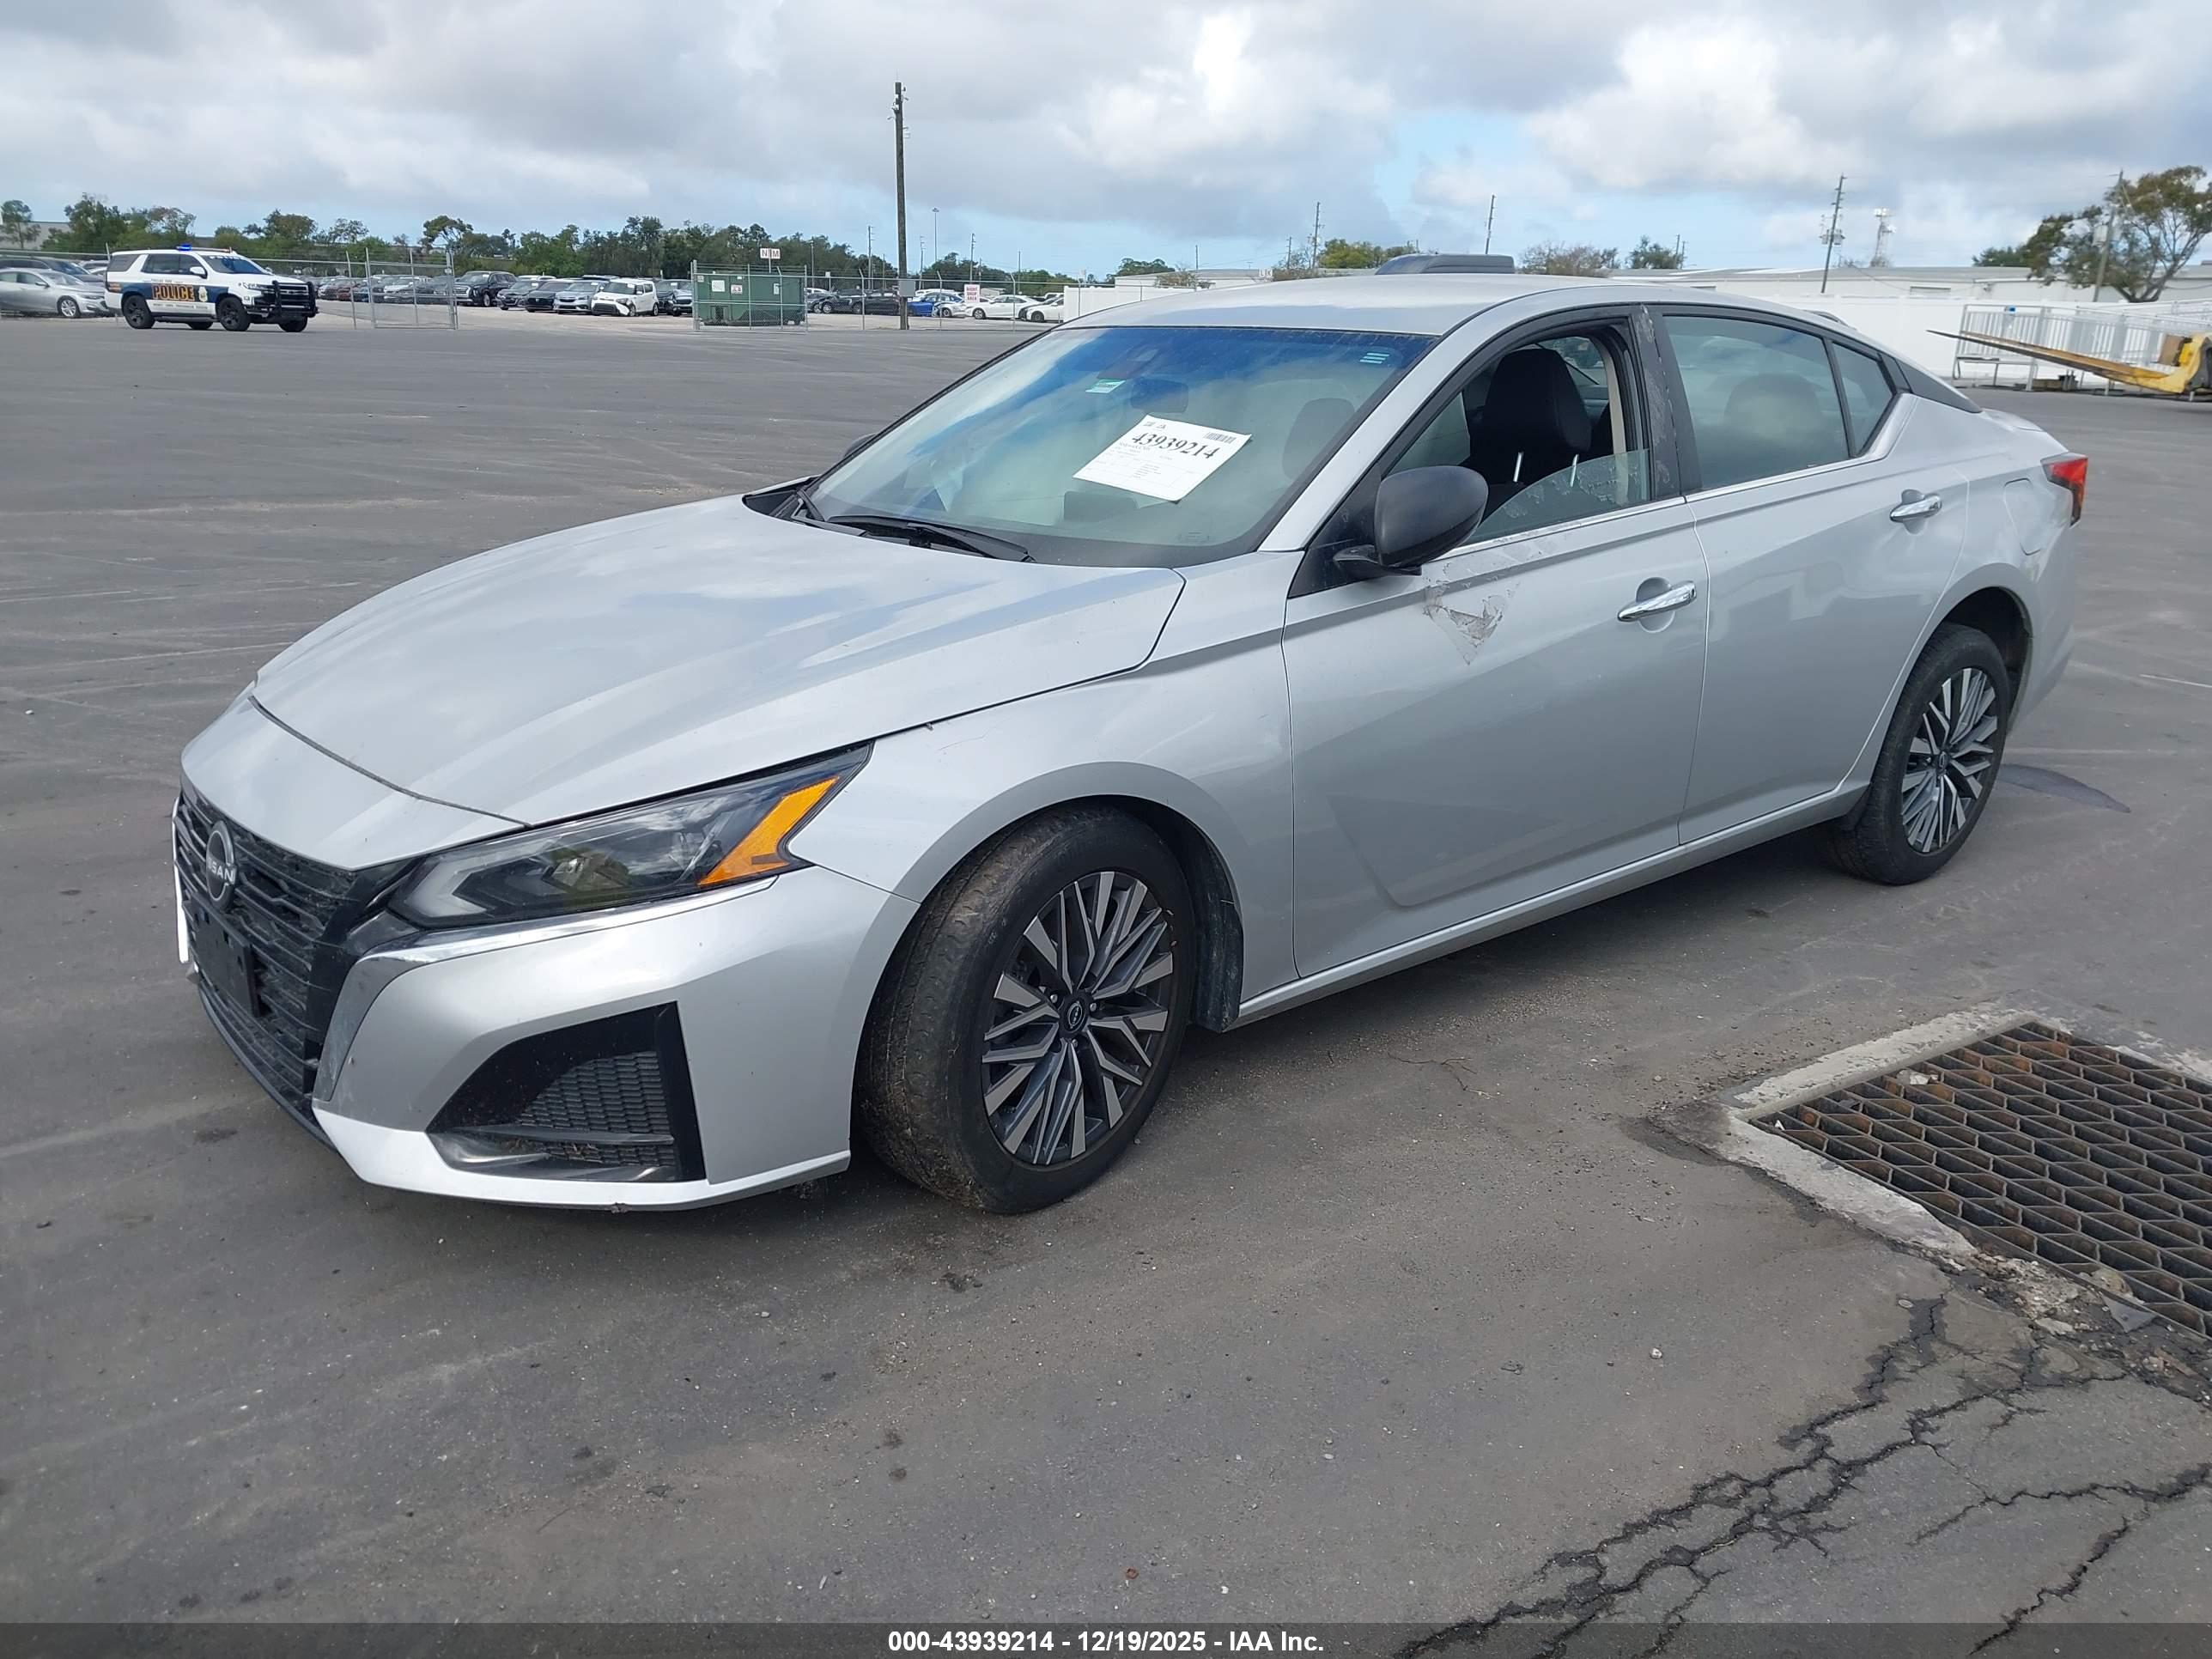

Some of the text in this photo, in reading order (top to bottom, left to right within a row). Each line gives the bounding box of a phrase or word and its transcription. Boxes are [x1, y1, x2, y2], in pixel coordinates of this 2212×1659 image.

[152, 284, 195, 301] POLICE
[1132, 432, 1221, 459] 43939214
[207, 856, 235, 884] SSAN
